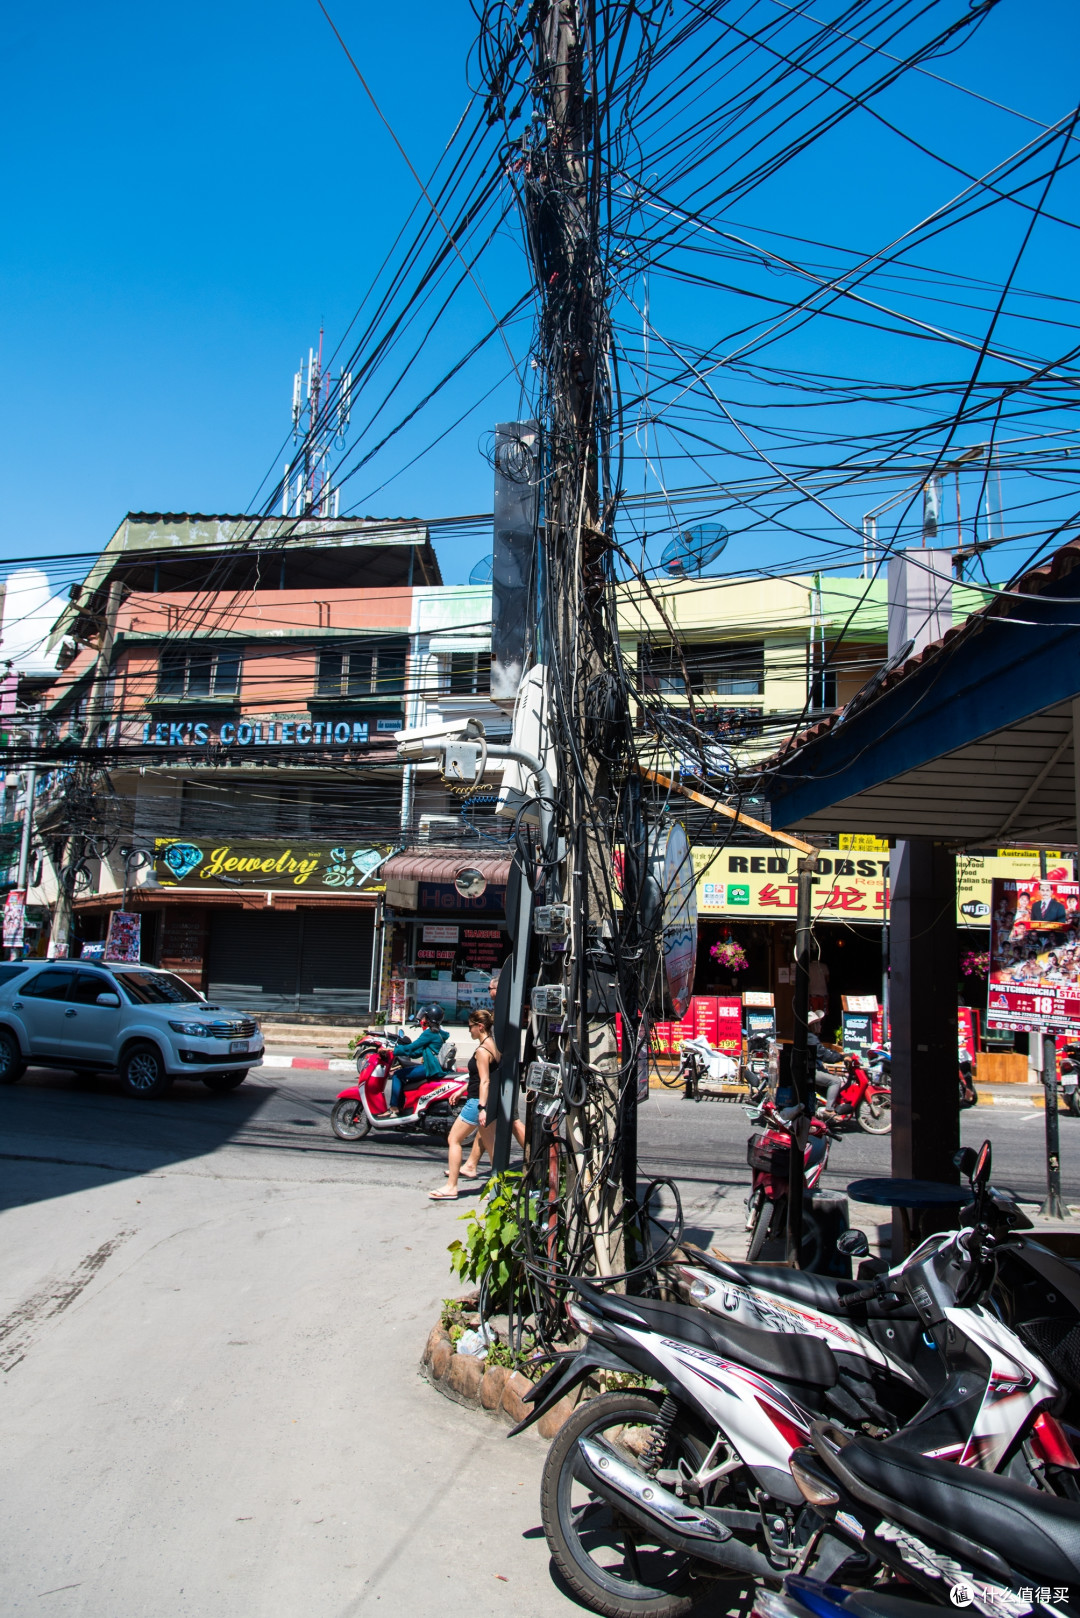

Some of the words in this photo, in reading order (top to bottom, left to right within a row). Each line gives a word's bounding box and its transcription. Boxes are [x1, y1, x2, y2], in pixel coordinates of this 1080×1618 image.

[143, 722, 209, 745] LEK'S
[220, 722, 369, 745] COLLECTION
[200, 846, 319, 885] Jewelry
[728, 856, 788, 874] RED
[797, 857, 890, 878] OBST
[1003, 882, 1035, 893] HAPPY
[464, 929, 501, 939] TRANSFER
[418, 950, 435, 958] OPEN
[436, 951, 456, 959] DAILY
[990, 984, 1056, 997] PHETCHBUNCHA
[1032, 997, 1052, 1014] 18
